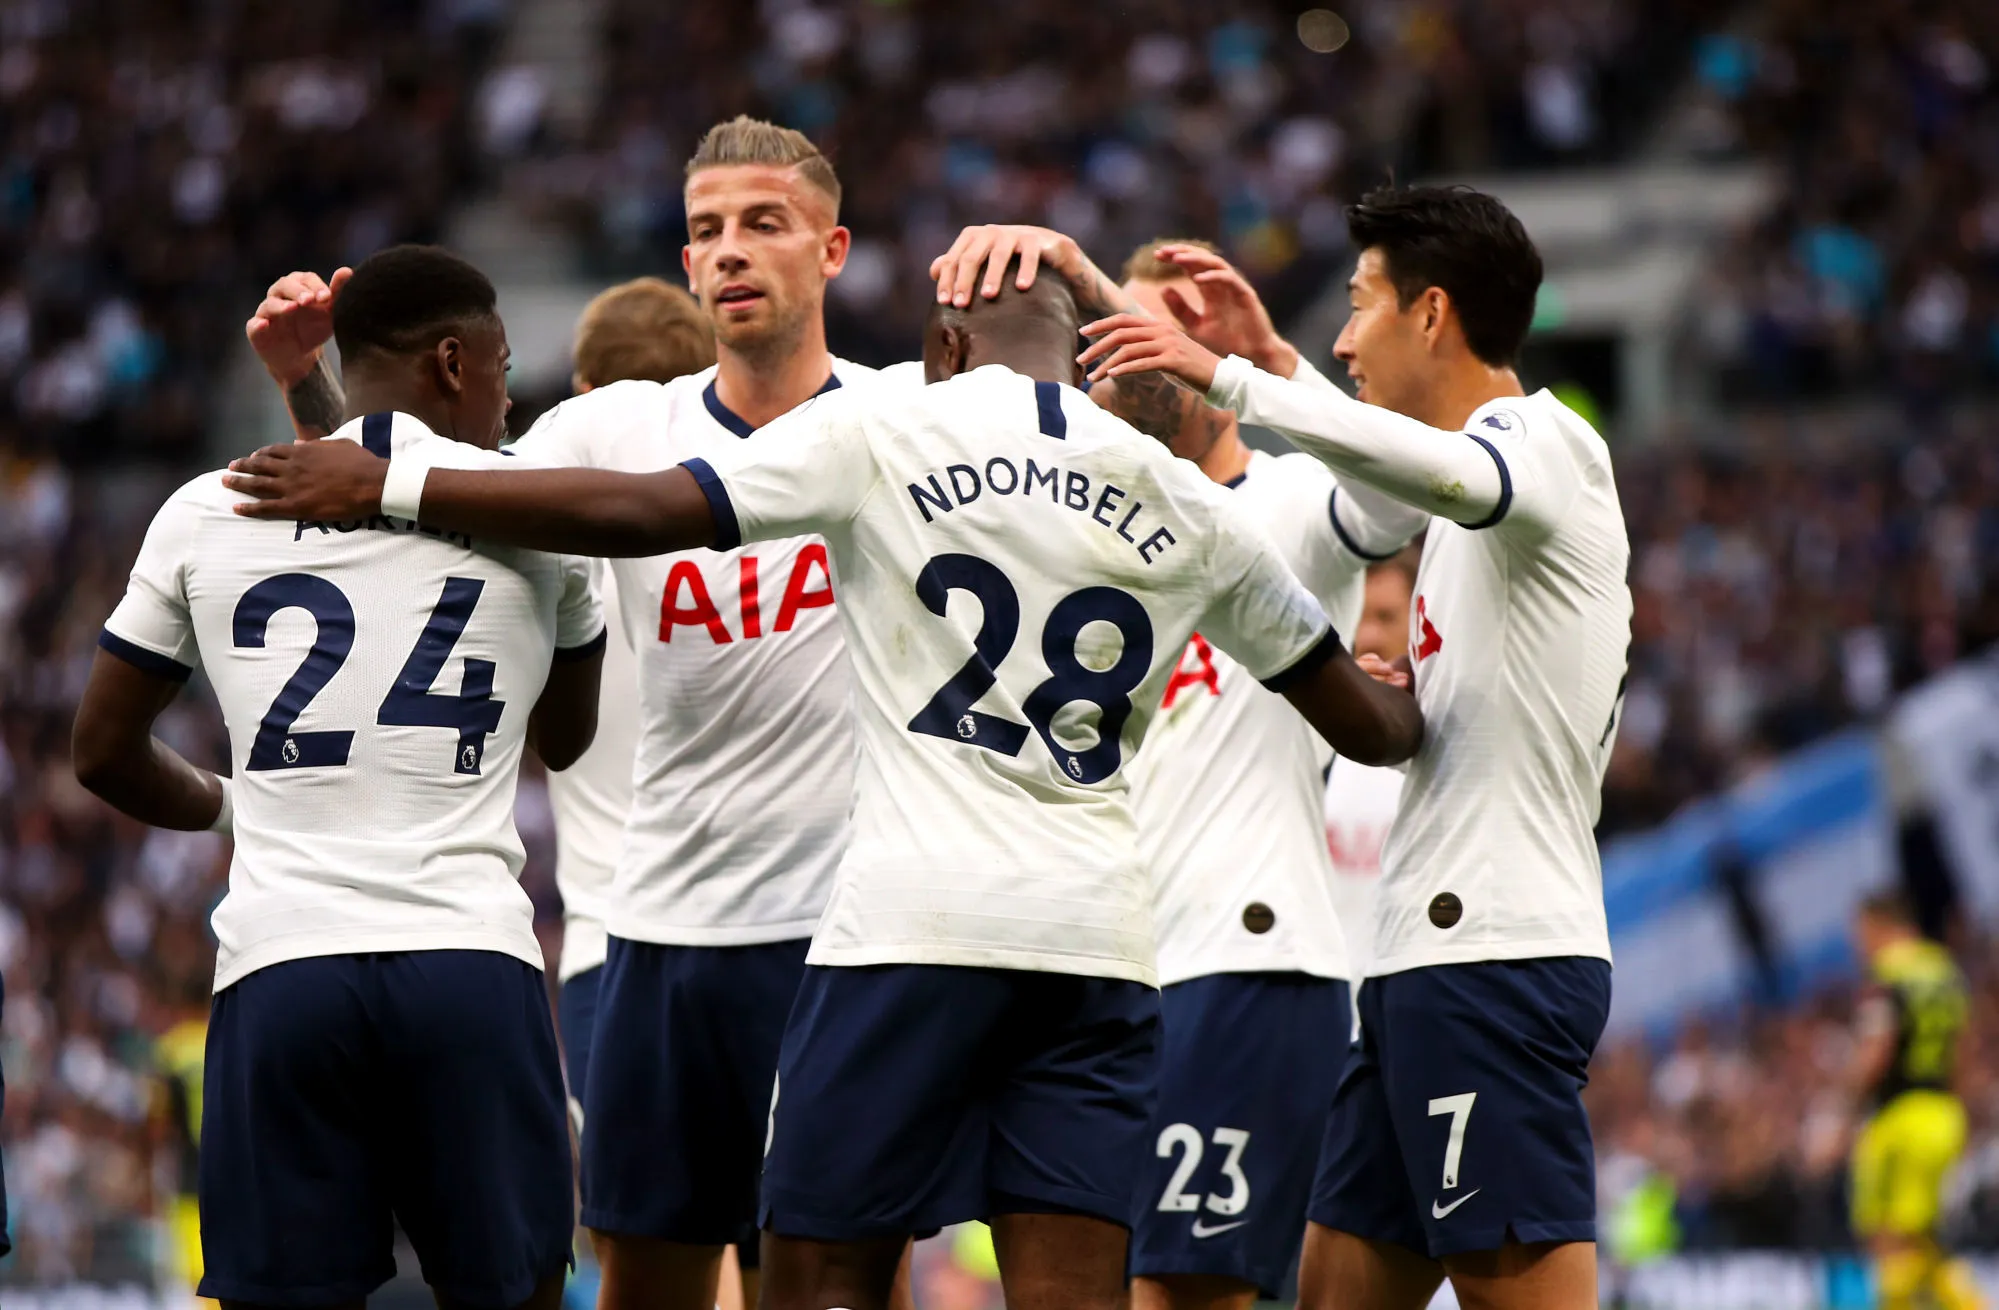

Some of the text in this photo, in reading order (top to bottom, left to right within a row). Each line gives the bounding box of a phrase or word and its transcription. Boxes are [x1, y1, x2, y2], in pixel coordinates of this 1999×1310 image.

[907, 457, 1177, 565] NDOMBELE
[658, 543, 836, 645] AIA
[232, 572, 507, 775] 24
[907, 552, 1155, 785] 28
[1156, 1122, 1251, 1216] 23
[1427, 1092, 1477, 1190] 7
